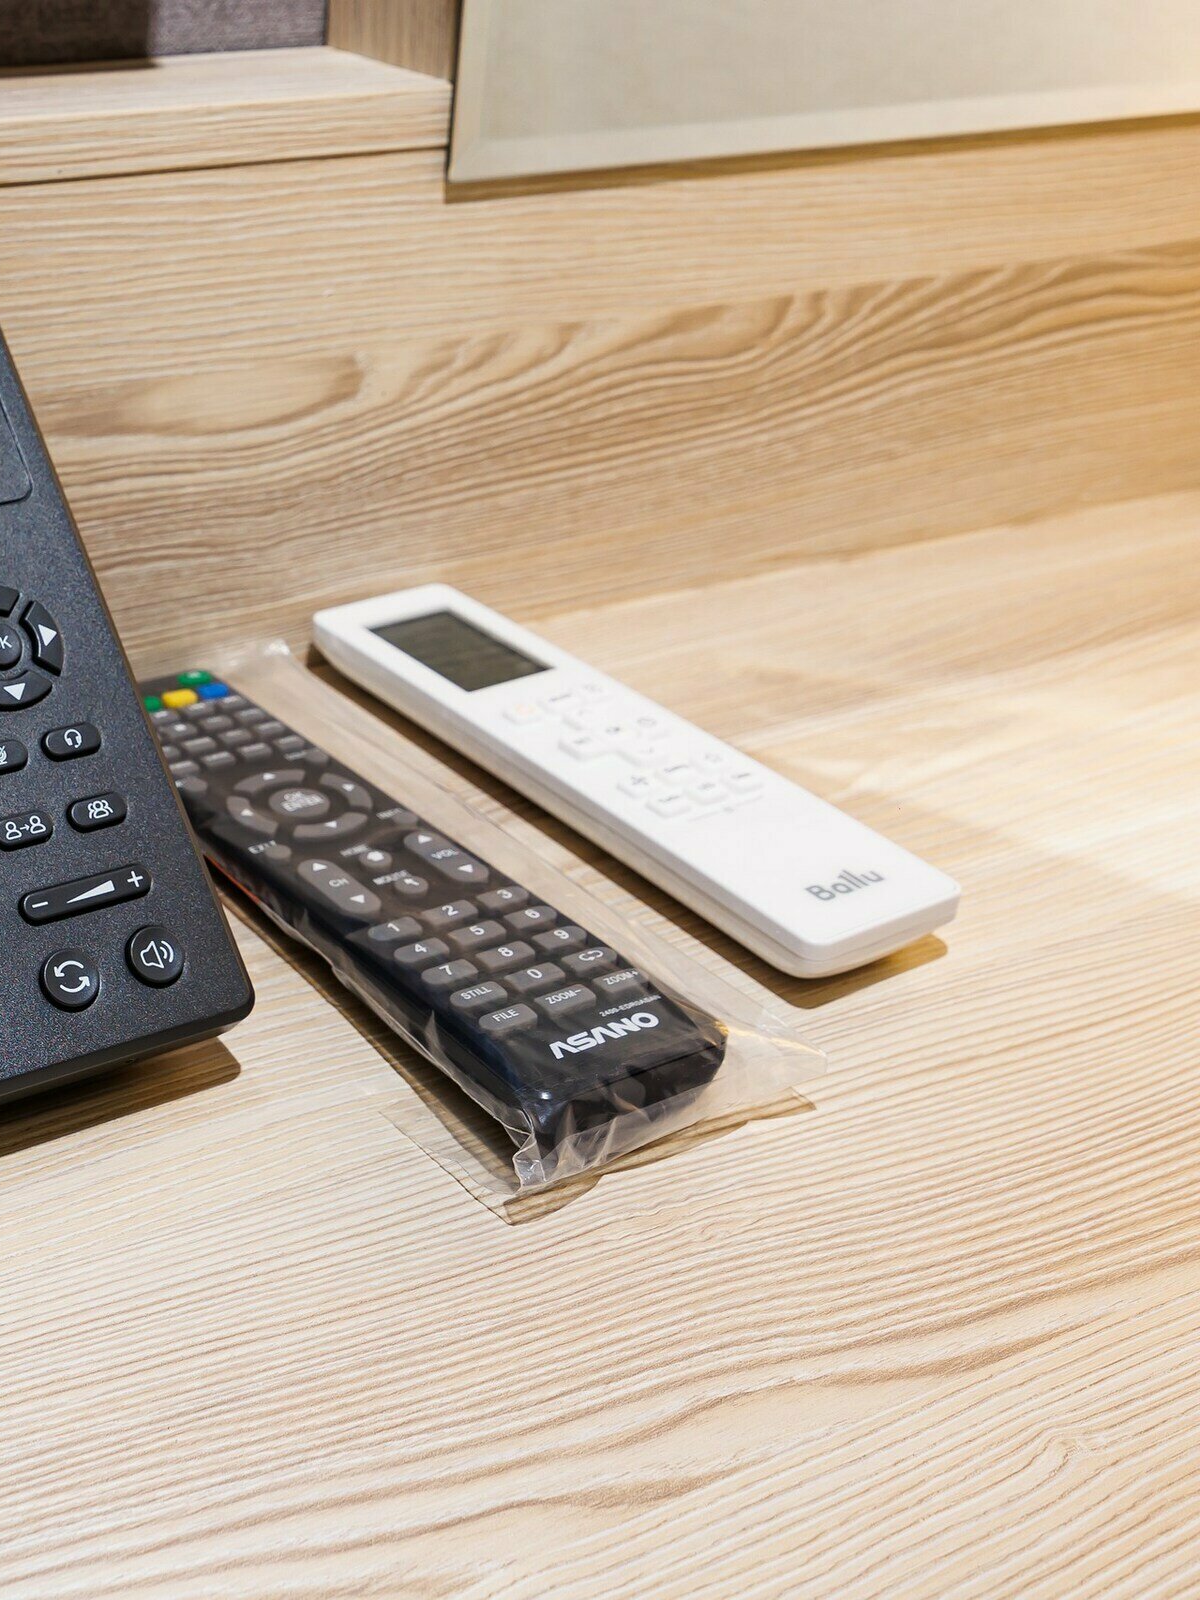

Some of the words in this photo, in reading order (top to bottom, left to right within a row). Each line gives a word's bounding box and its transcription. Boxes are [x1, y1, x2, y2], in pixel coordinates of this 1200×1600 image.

[805, 869, 885, 901] Ballu
[497, 889, 514, 900] 3
[441, 904, 460, 917] 2
[524, 909, 540, 920] 6
[387, 922, 401, 933] 1
[469, 925, 485, 936] 5
[553, 929, 570, 940] 9
[414, 943, 428, 955] 4
[497, 947, 514, 957] 8
[438, 964, 453, 976] 7
[526, 968, 543, 980] 0
[603, 969, 640, 986] ZOOM+
[460, 986, 493, 1001] STILL
[545, 988, 582, 1005] ZOOM-
[492, 1008, 520, 1023] FILE
[549, 1012, 660, 1060] ASANO
